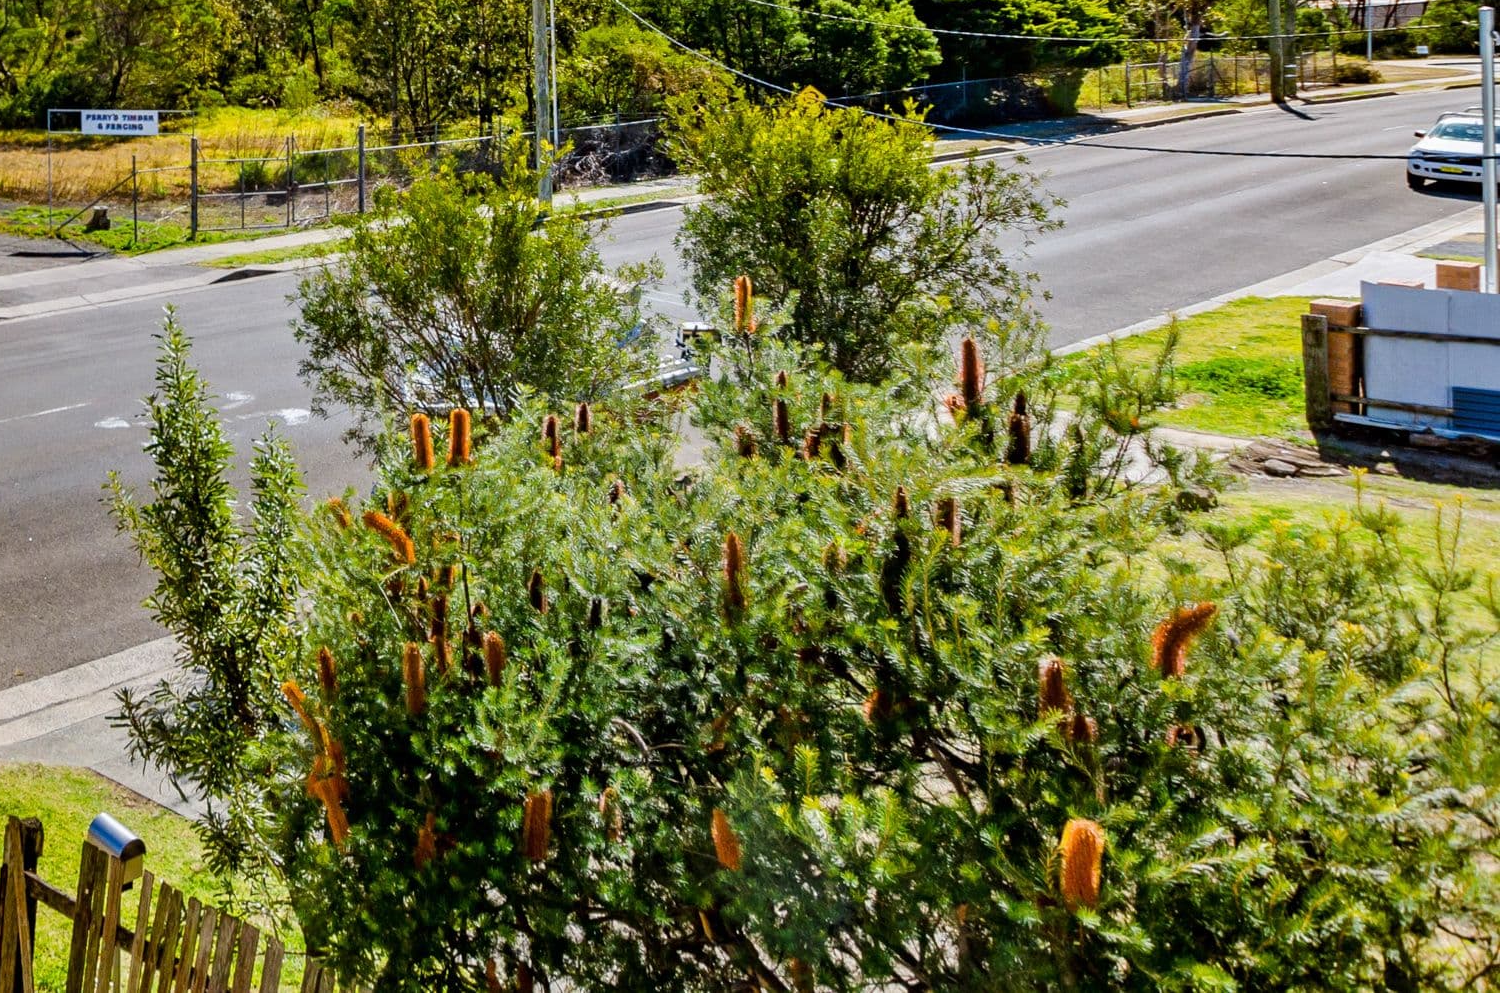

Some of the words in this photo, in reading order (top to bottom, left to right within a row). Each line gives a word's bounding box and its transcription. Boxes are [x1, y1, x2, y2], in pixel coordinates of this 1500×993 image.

[85, 114, 119, 122] PERRY'S
[121, 114, 155, 122] TIMBER
[105, 123, 144, 131] FENCING
